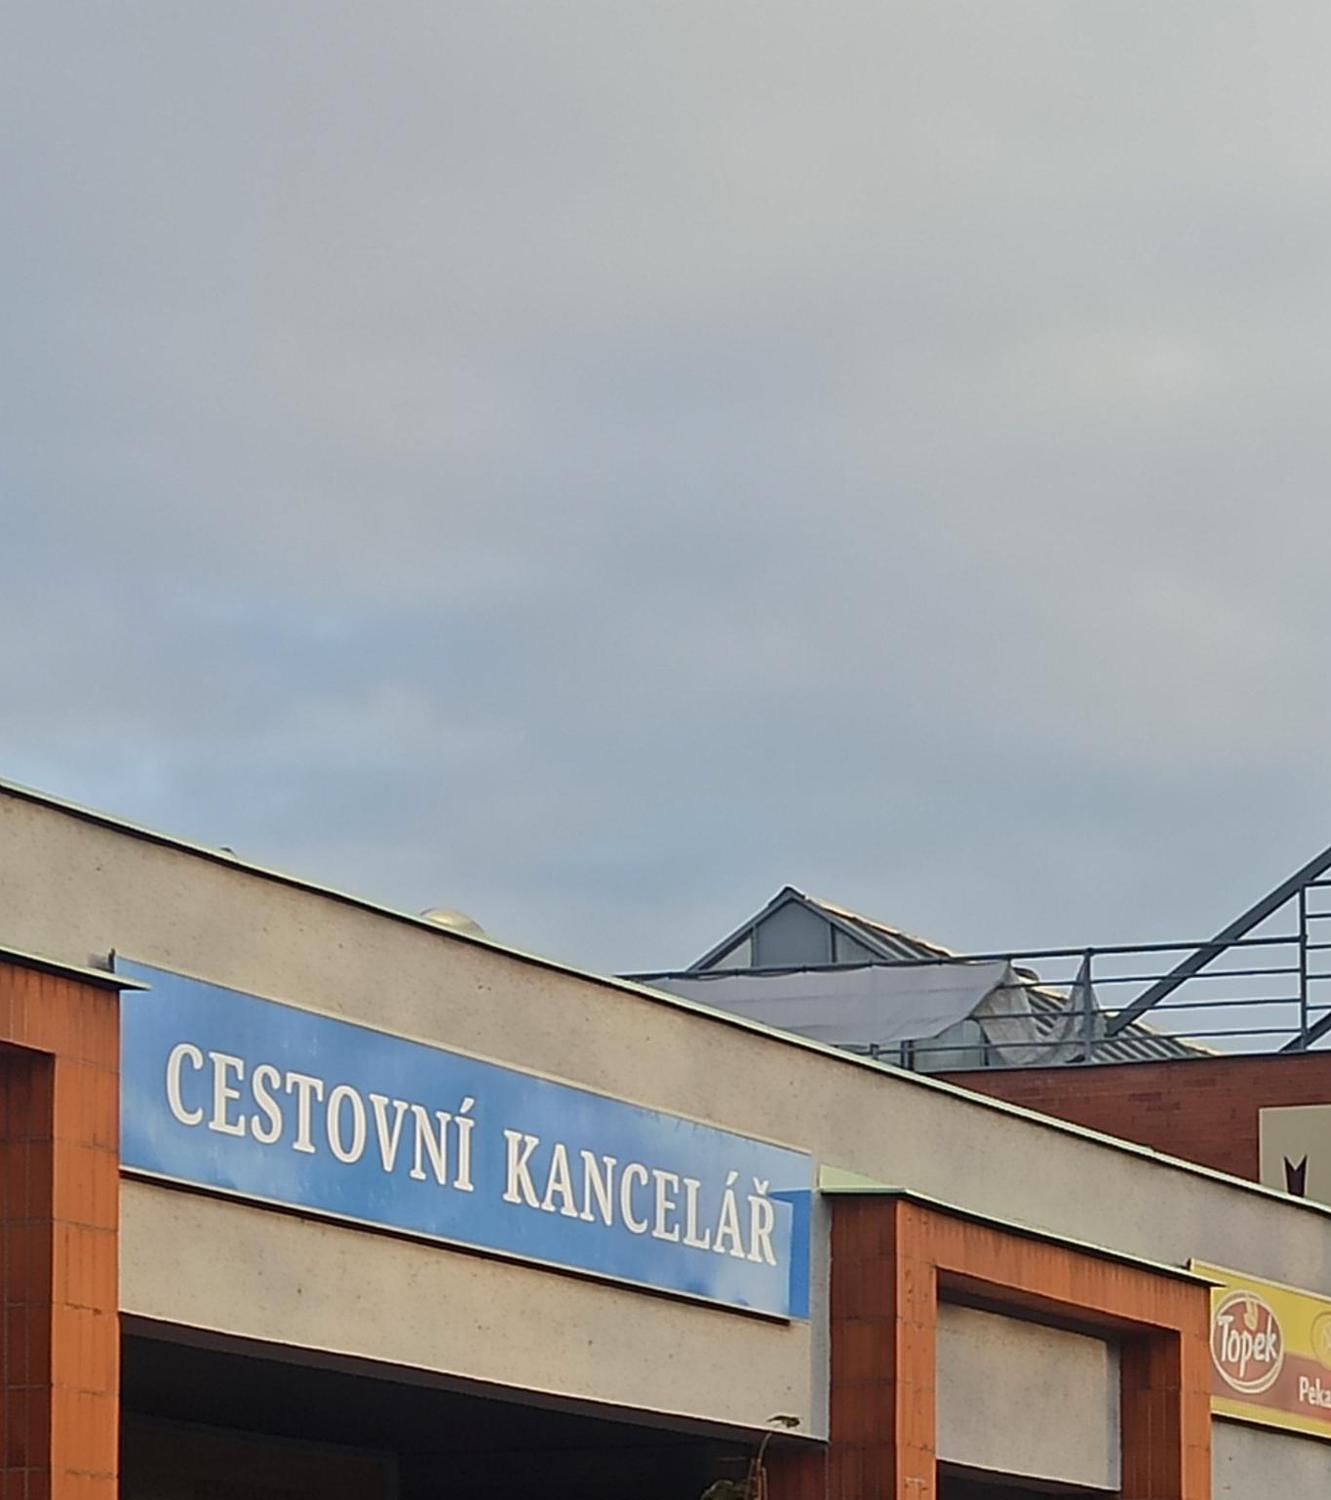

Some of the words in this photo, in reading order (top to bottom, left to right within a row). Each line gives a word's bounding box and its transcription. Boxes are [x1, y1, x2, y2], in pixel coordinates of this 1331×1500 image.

[166, 1043, 476, 1192] CESTOVNÍ
[502, 1128, 778, 1267] KANCELÁŘ
[1216, 1315, 1278, 1379] Topek
